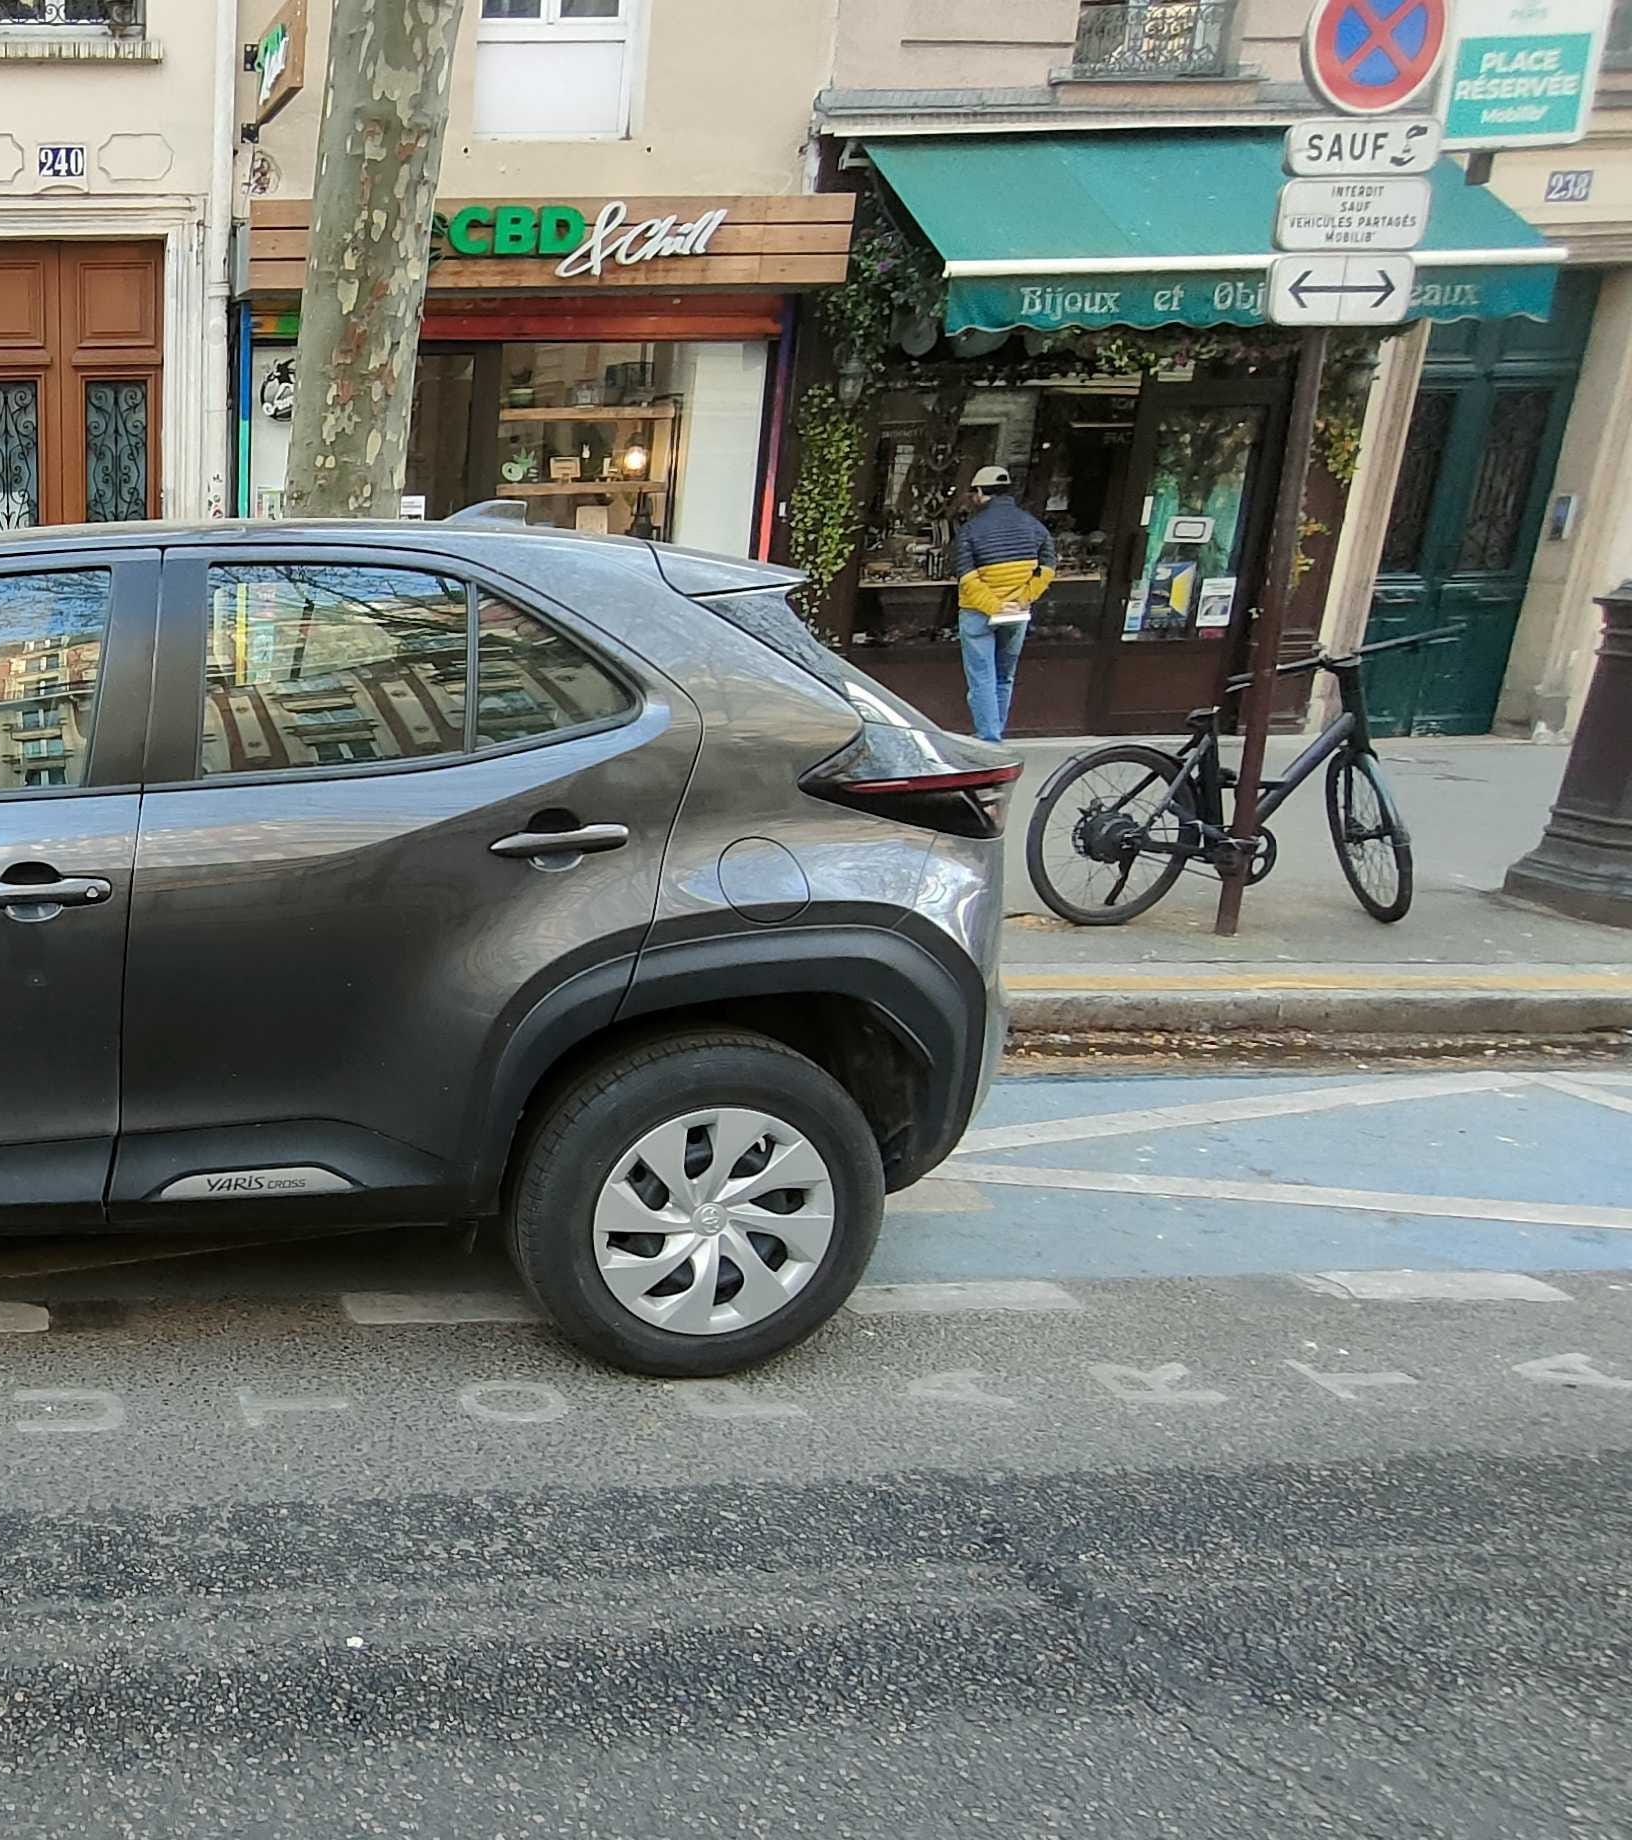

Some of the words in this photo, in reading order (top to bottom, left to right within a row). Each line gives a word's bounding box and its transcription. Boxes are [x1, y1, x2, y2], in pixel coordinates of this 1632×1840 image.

[1480, 48, 1562, 74] PLACE
[1454, 70, 1581, 100] RÉSERVÉE
[1306, 132, 1389, 162] SAUF
[39, 148, 85, 177] 240
[1331, 185, 1385, 198] INTERDIT
[1547, 175, 1590, 201] 238
[1340, 201, 1372, 213] SAUF
[447, 205, 587, 256] CBD
[1357, 214, 1417, 228] PARTAGÉS
[1020, 286, 1121, 321] Bijoux
[1153, 284, 1184, 312] et
[1214, 281, 1266, 315] Obj
[207, 1175, 265, 1192] YARIS
[267, 1178, 307, 1189] CROSS
